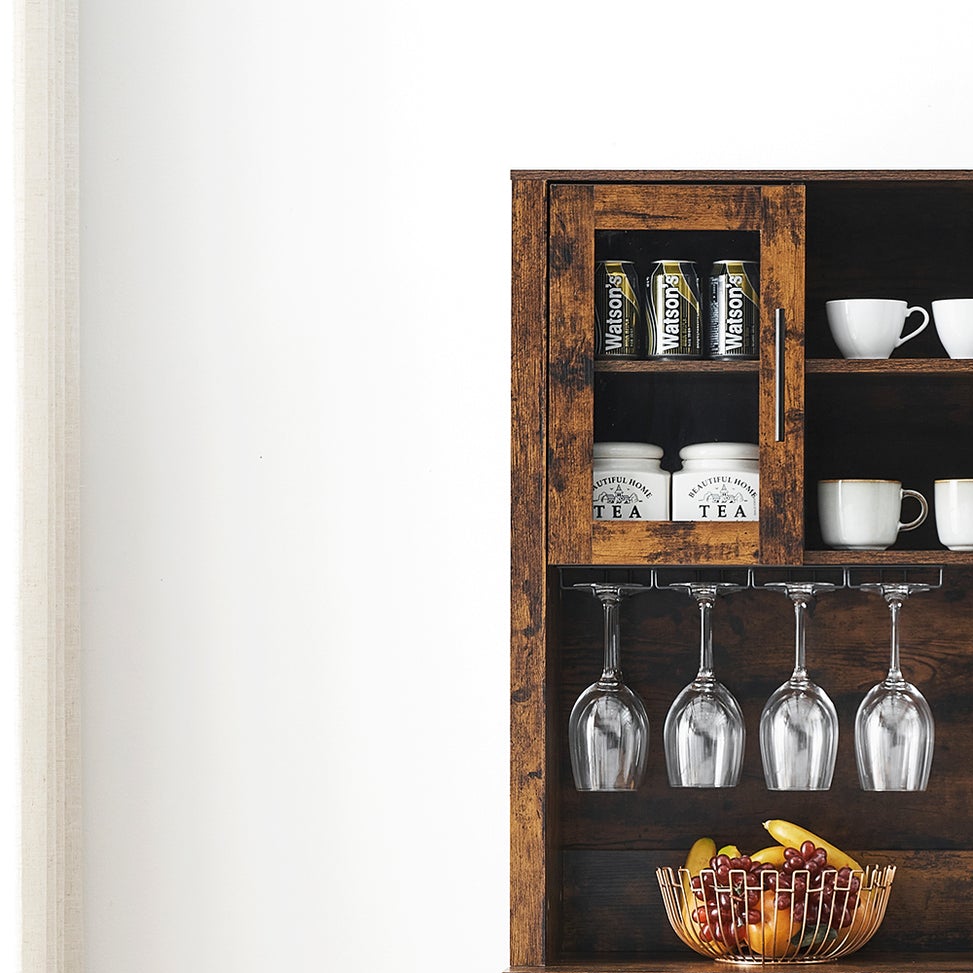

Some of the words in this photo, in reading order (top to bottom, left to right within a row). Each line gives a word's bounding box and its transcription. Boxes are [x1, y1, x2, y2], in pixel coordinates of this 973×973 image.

[605, 275, 623, 350] Watson's
[662, 275, 680, 350] Watson's
[725, 275, 743, 350] Watson's
[593, 477, 627, 491] AUTIFUL
[629, 478, 652, 499] HOME
[688, 476, 731, 498] BEAUTIFUL
[734, 478, 757, 498] HOME
[594, 505, 642, 518] TEA
[699, 505, 746, 518] TEA
